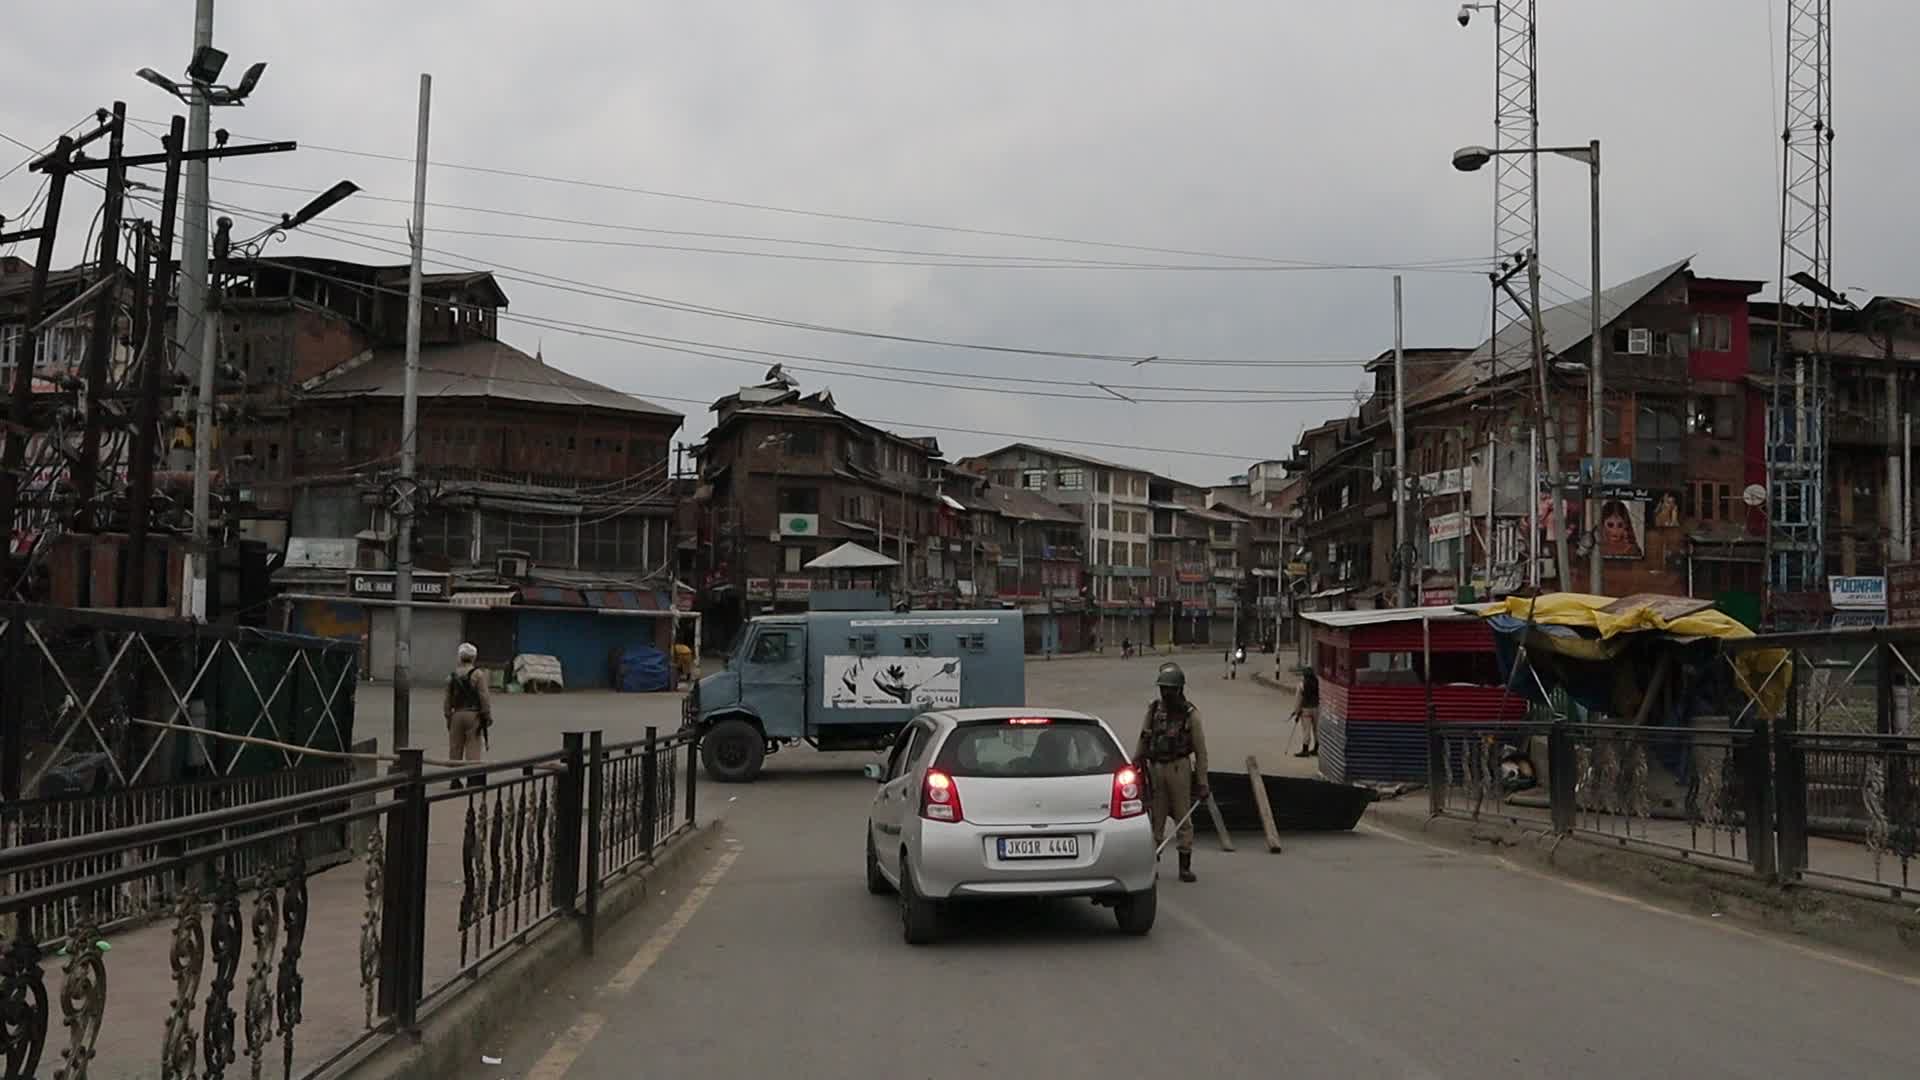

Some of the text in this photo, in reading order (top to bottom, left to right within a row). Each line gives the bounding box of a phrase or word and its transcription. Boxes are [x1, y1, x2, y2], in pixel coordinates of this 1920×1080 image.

[1832, 579, 1882, 593] POONAM
[1008, 841, 1041, 855] JK01R
[1049, 839, 1075, 853] 4440
